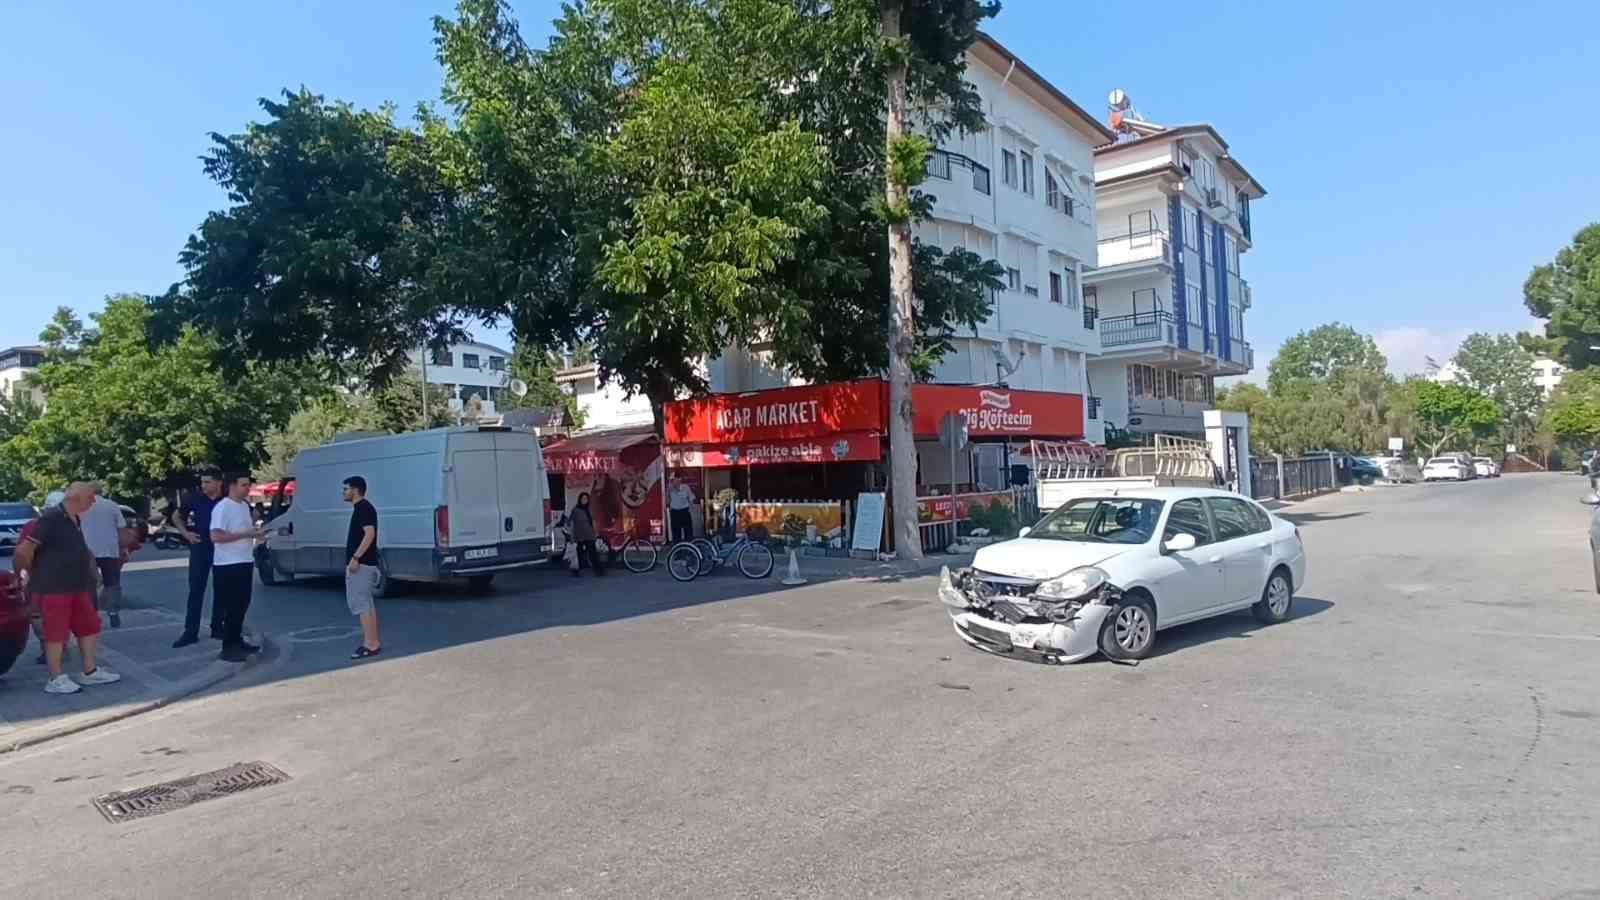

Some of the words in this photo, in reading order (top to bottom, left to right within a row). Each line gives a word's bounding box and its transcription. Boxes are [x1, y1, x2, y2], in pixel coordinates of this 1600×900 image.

[716, 407, 751, 430] ACAR
[756, 400, 818, 427] MARKET
[568, 456, 617, 471] MARKET
